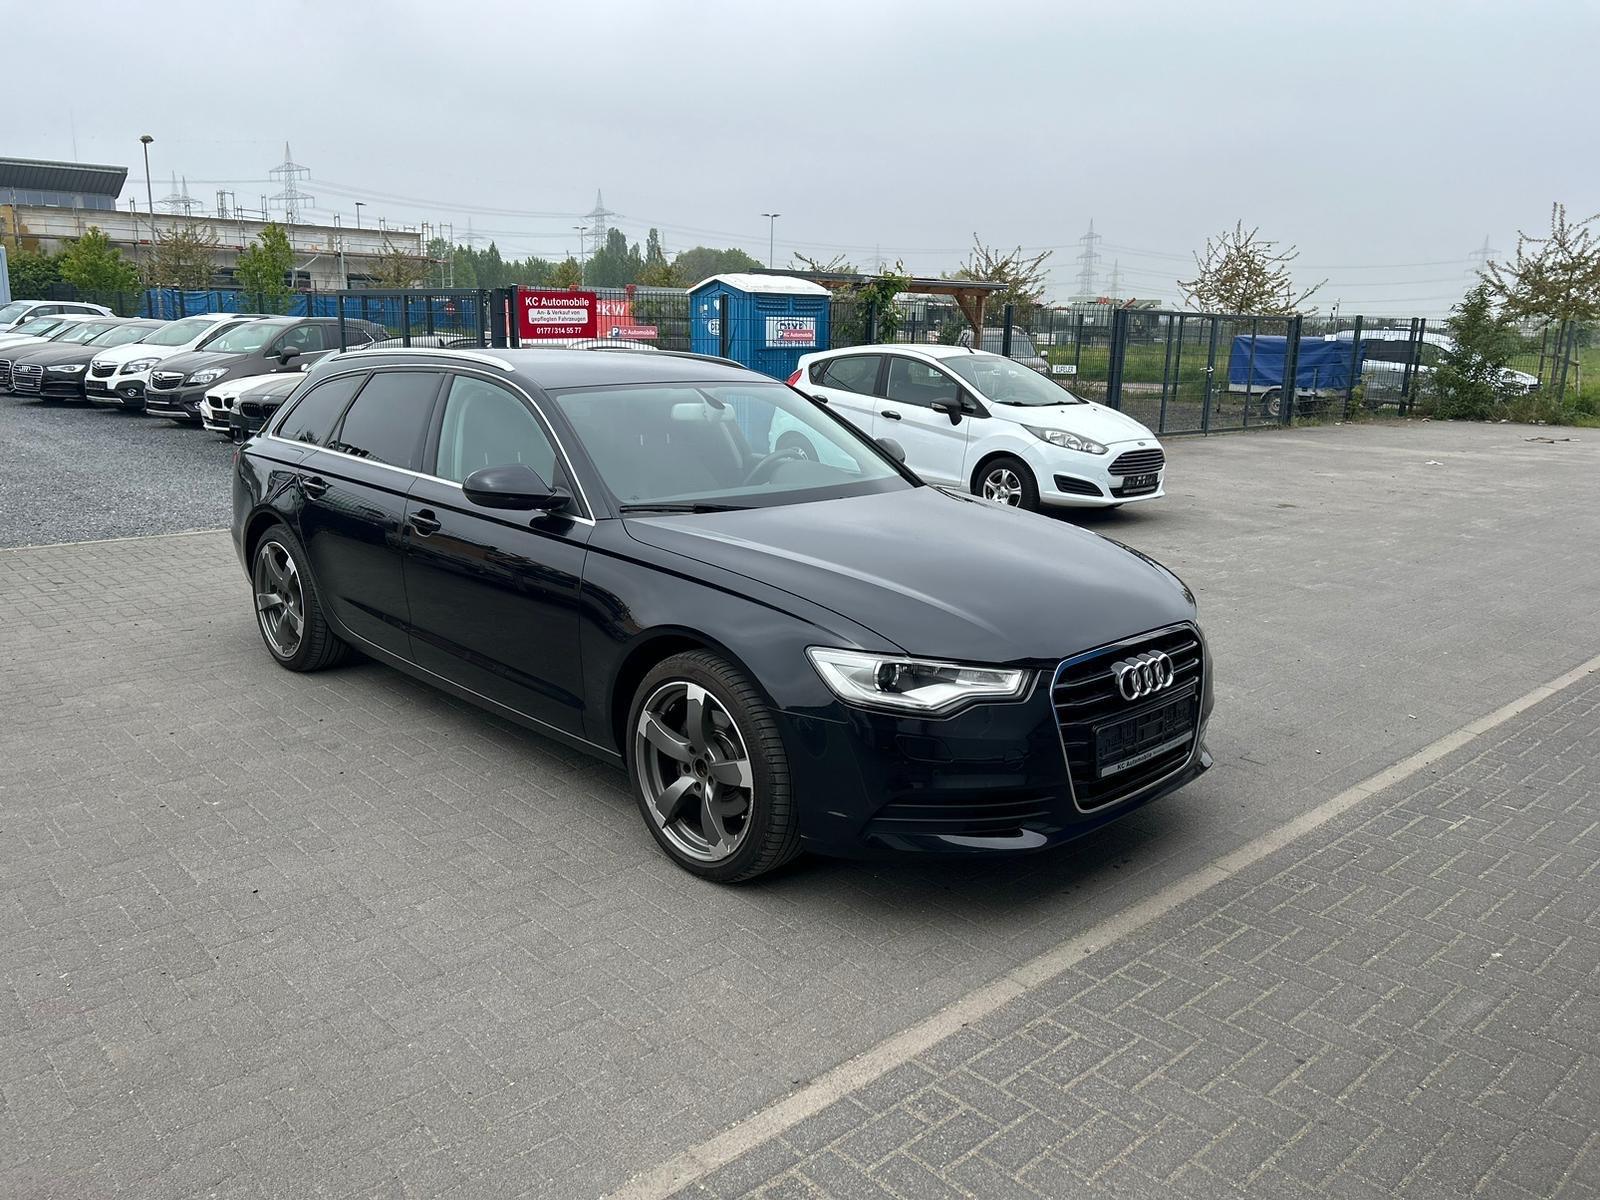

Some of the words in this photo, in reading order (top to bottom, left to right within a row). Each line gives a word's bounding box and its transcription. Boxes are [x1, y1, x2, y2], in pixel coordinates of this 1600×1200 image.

[525, 297, 539, 306] KC
[541, 297, 590, 307] Automobile
[612, 328, 619, 336] P
